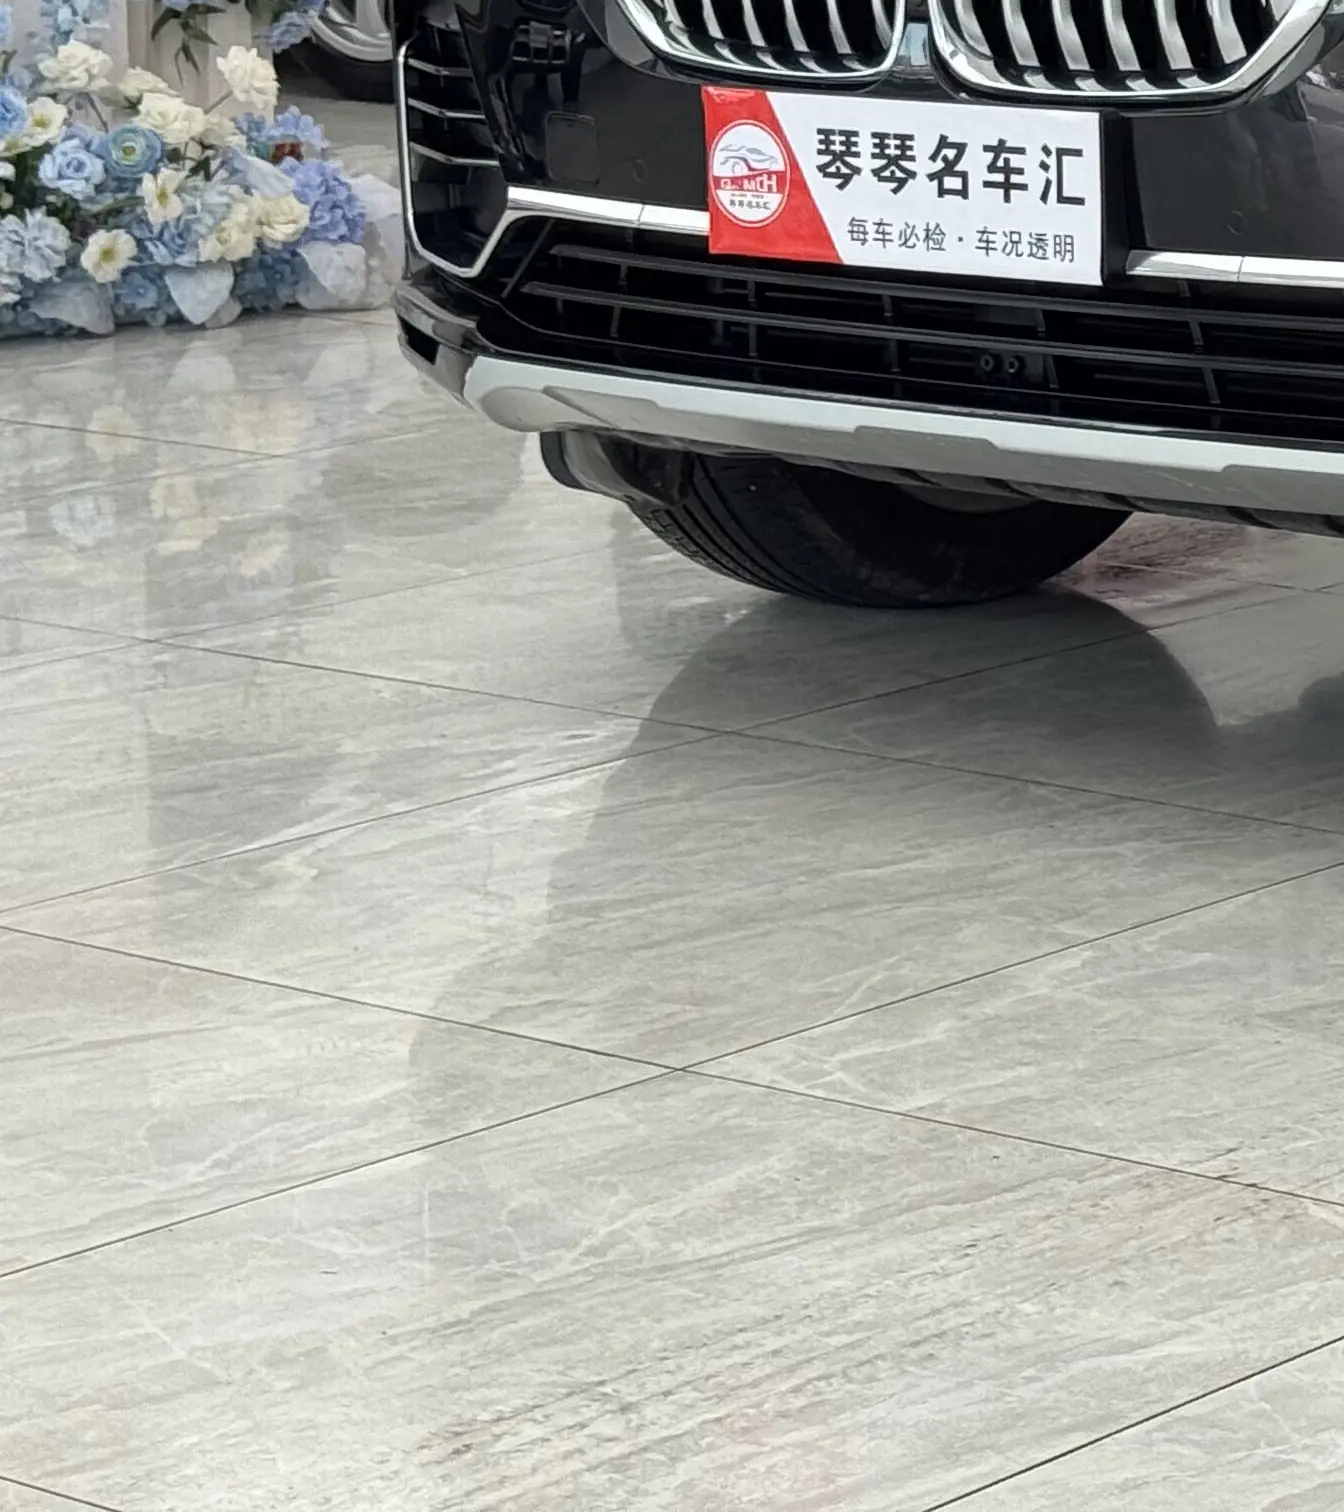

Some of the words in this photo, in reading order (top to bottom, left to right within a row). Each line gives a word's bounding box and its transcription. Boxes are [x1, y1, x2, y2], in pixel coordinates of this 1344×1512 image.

[815, 128, 1086, 207] 琴琴名车汇
